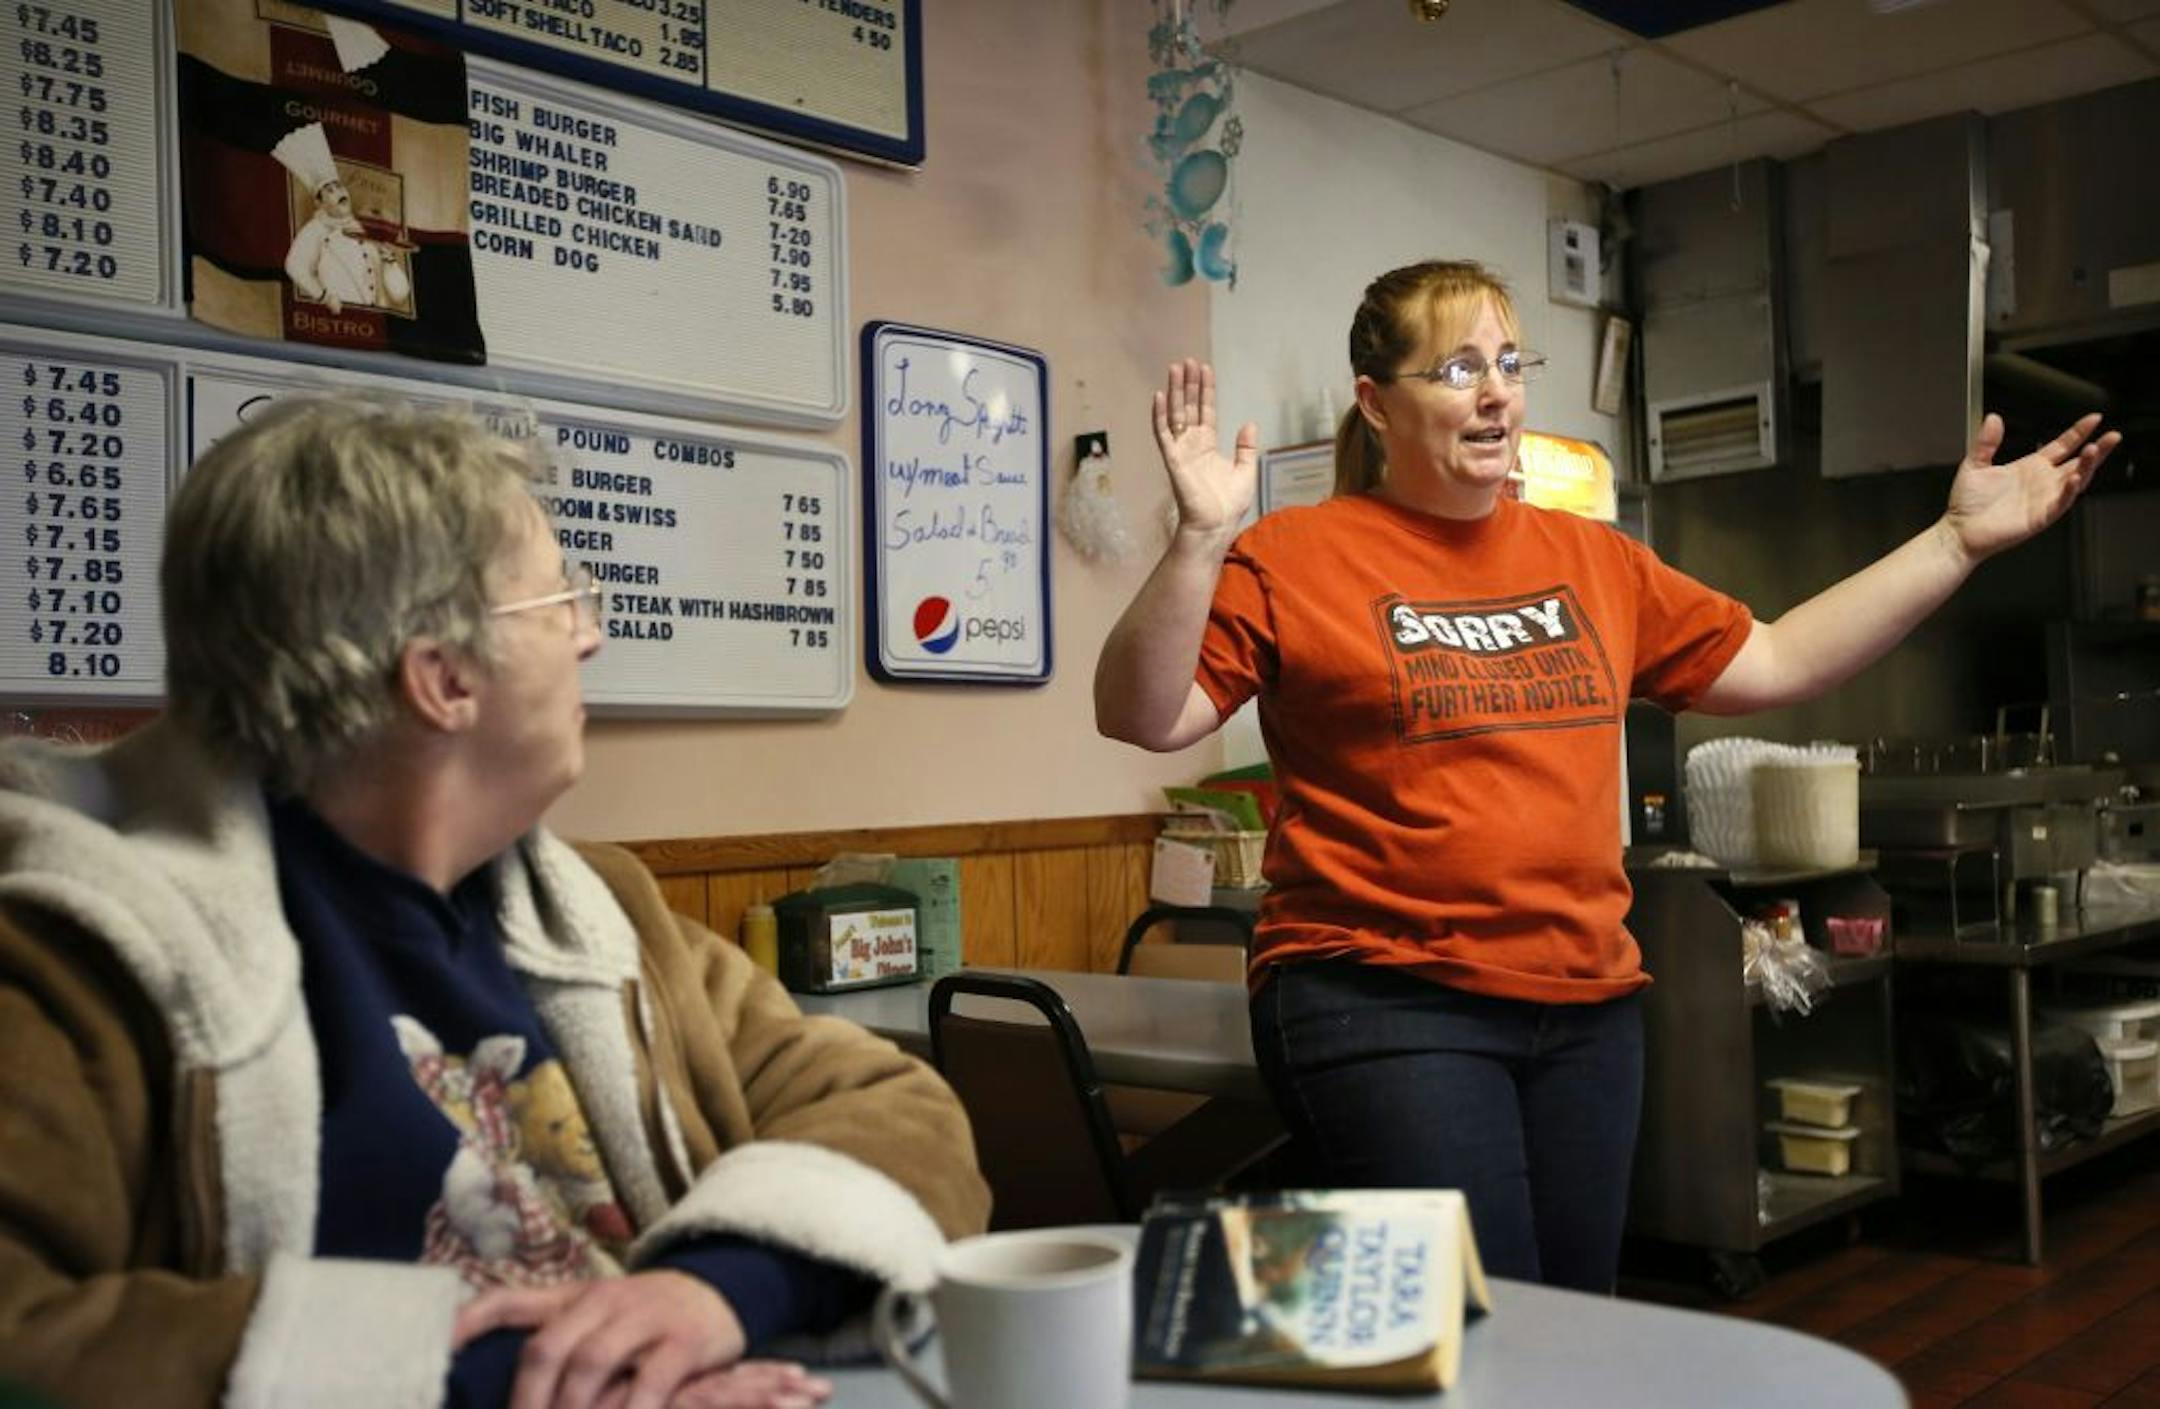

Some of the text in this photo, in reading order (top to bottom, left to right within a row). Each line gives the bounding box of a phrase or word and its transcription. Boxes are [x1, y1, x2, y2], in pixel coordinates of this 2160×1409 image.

[524, 9, 588, 43] SHELL
[590, 27, 642, 57] TACO
[286, 101, 377, 134] GOURMET
[470, 90, 617, 146] FISH BURGER
[467, 119, 608, 171] BIG WHALER
[469, 148, 637, 206] SHRIMP BURGER
[469, 173, 722, 248] BREADED CHICKEN SAND
[469, 201, 660, 260] GRILLED CHICKEN
[474, 231, 599, 272] CORN DOG
[770, 271, 812, 294] 7.95
[293, 312, 374, 338] BISTRO
[557, 426, 630, 455] POUND
[653, 440, 735, 469] COMBOS
[571, 468, 652, 496] BURGER
[612, 593, 672, 615] STEAK
[679, 598, 723, 618] WITH
[729, 602, 834, 624] HASHBROWN
[1393, 598, 1565, 651] SORRY
[608, 619, 673, 640] SALAD
[964, 614, 1026, 646] pepsi
[48, 652, 120, 677] 8.10
[1405, 652, 1459, 682] MIND
[1459, 654, 1534, 680] CLOSED
[1410, 683, 1517, 721] FURTHER
